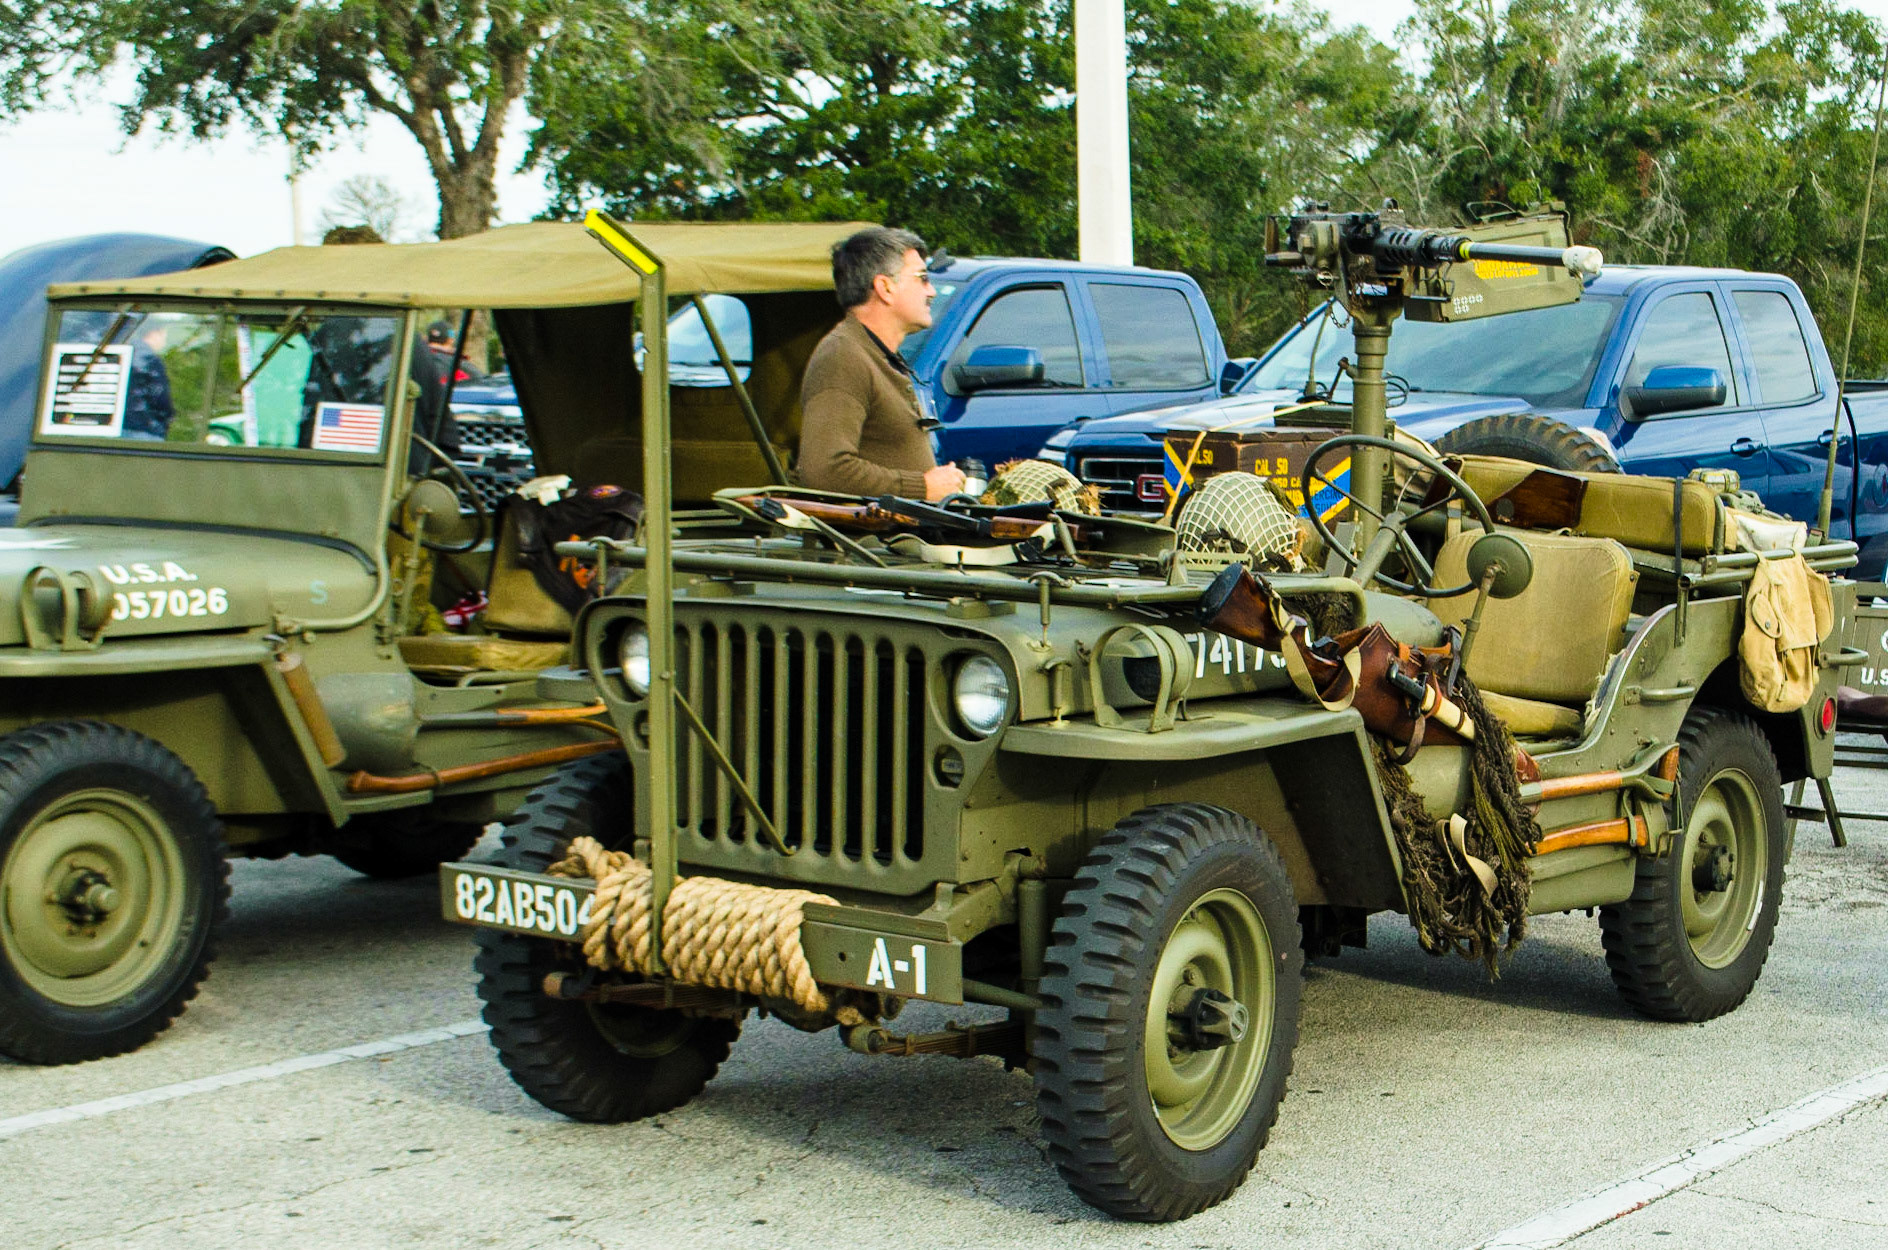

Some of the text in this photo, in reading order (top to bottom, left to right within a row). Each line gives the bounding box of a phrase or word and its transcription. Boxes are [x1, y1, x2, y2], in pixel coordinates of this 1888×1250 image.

[1254, 458, 1272, 476] CAL
[99, 561, 199, 585] U.S.A.
[866, 937, 927, 995] A-1
